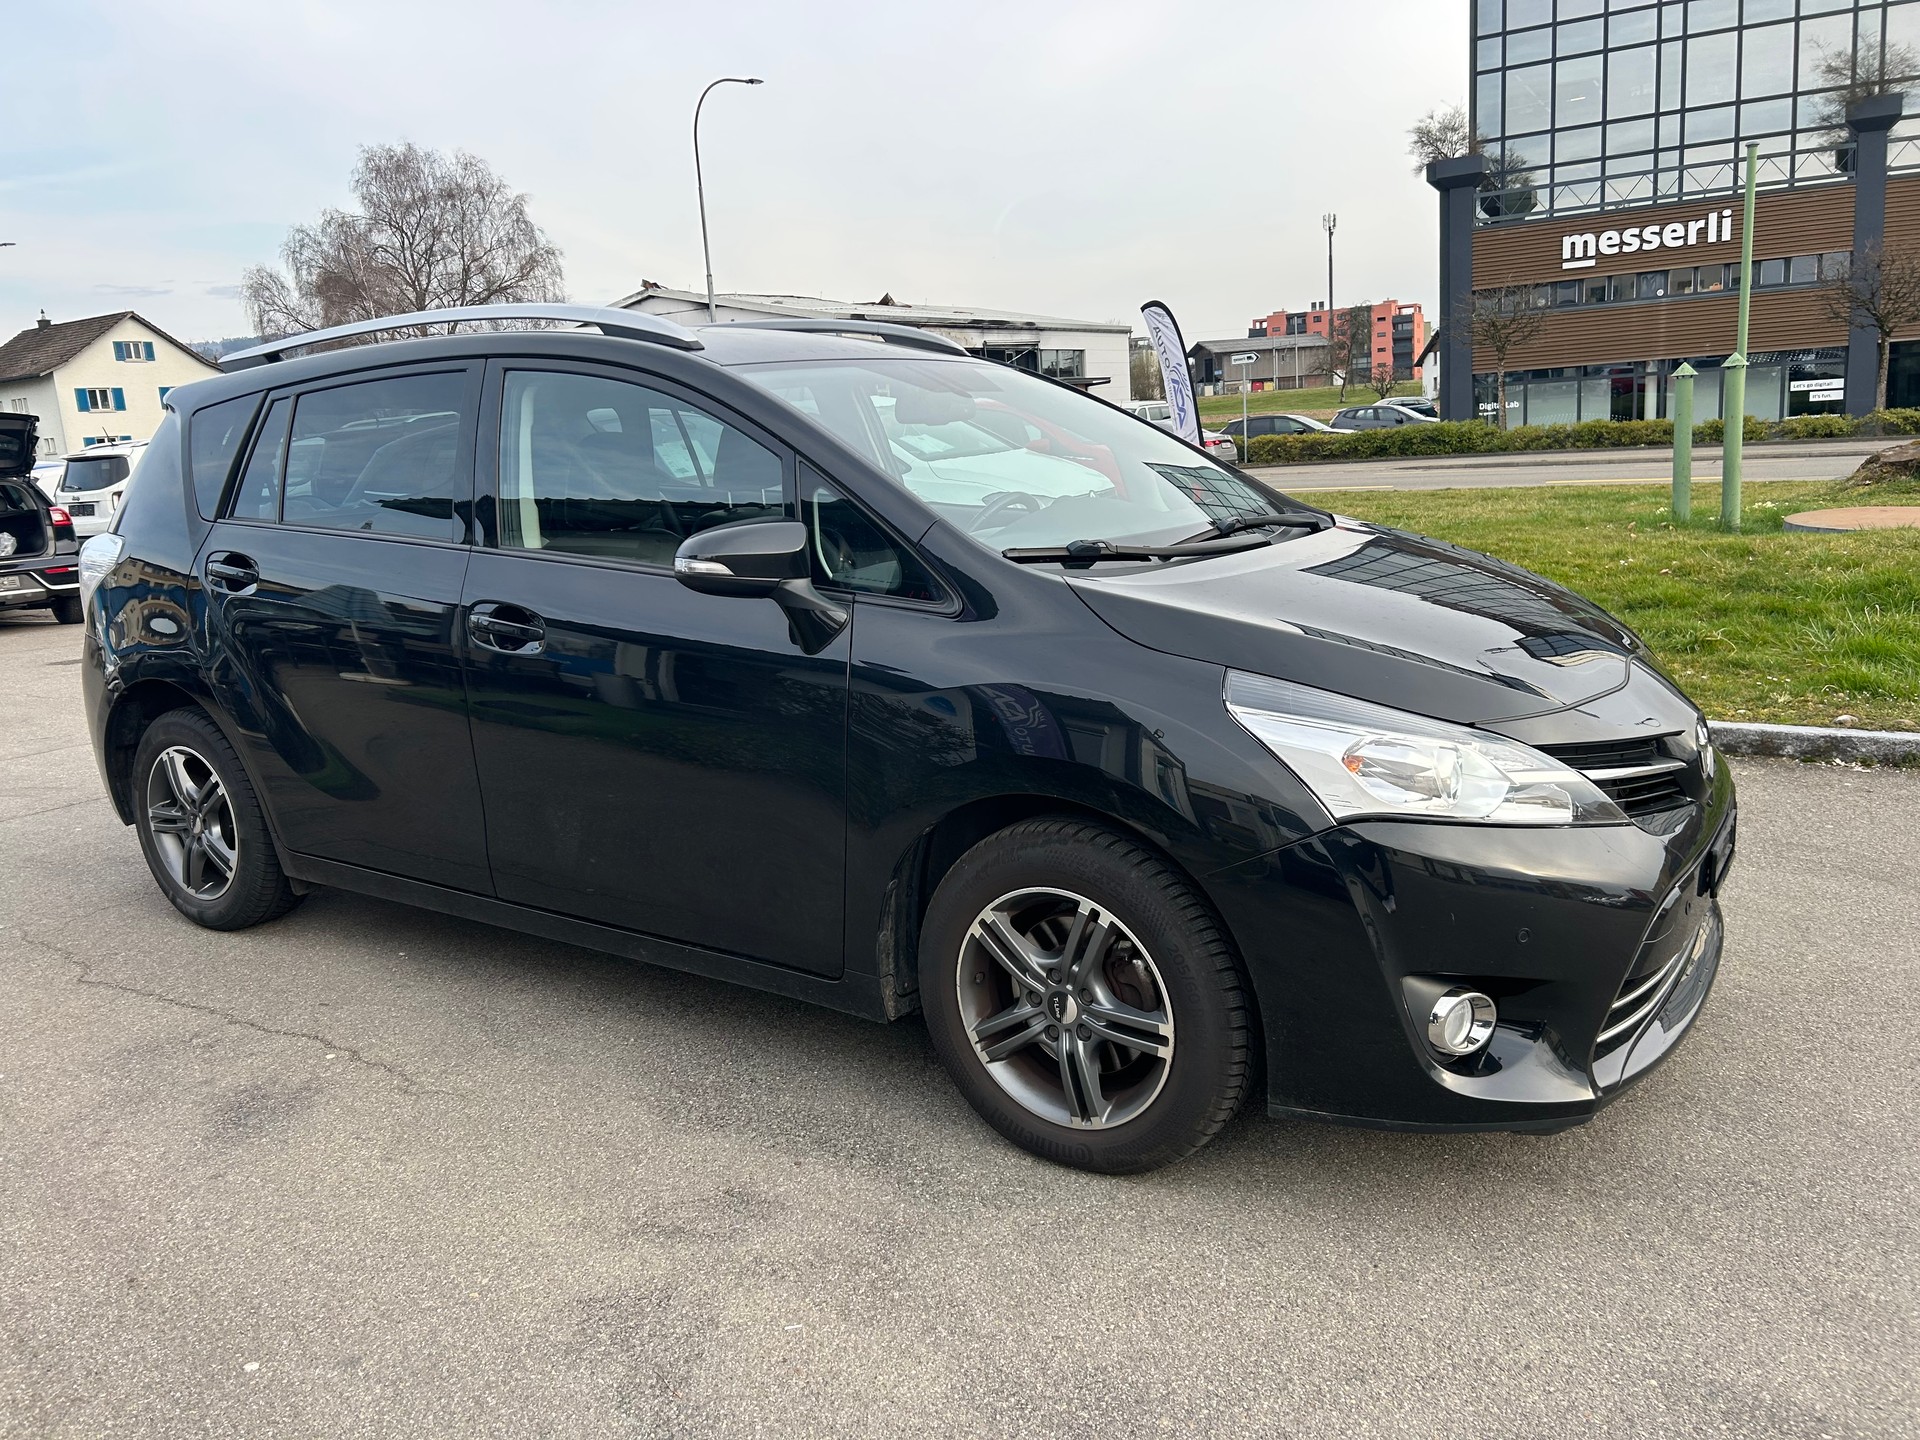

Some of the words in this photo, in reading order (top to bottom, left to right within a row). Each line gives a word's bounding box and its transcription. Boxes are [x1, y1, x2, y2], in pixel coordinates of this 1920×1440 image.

[1562, 209, 1732, 260] messerli
[1153, 326, 1170, 369] AUTO
[1505, 401, 1519, 409] Lab
